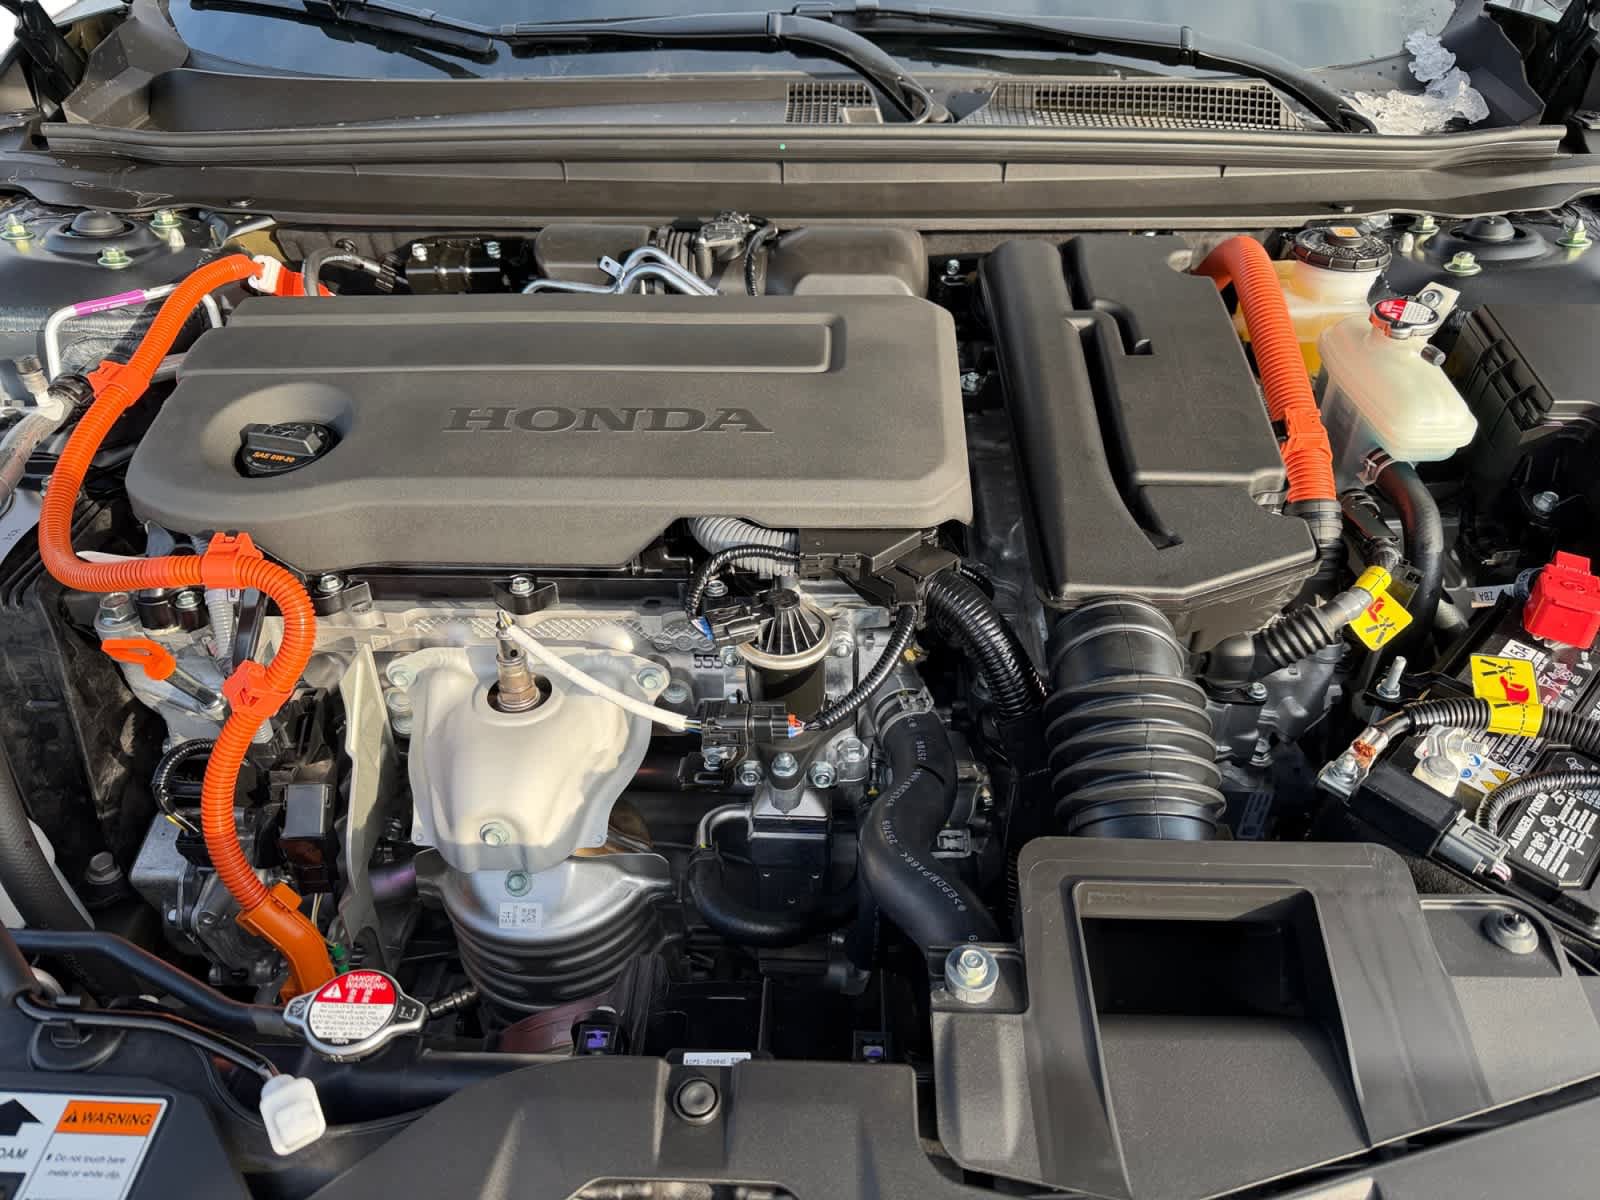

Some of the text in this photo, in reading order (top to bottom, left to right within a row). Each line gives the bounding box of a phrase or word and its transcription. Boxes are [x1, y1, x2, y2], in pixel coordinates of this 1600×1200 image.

[443, 407, 774, 433] HONDA
[252, 451, 271, 459] SAE
[82, 1111, 152, 1126] WARNING
